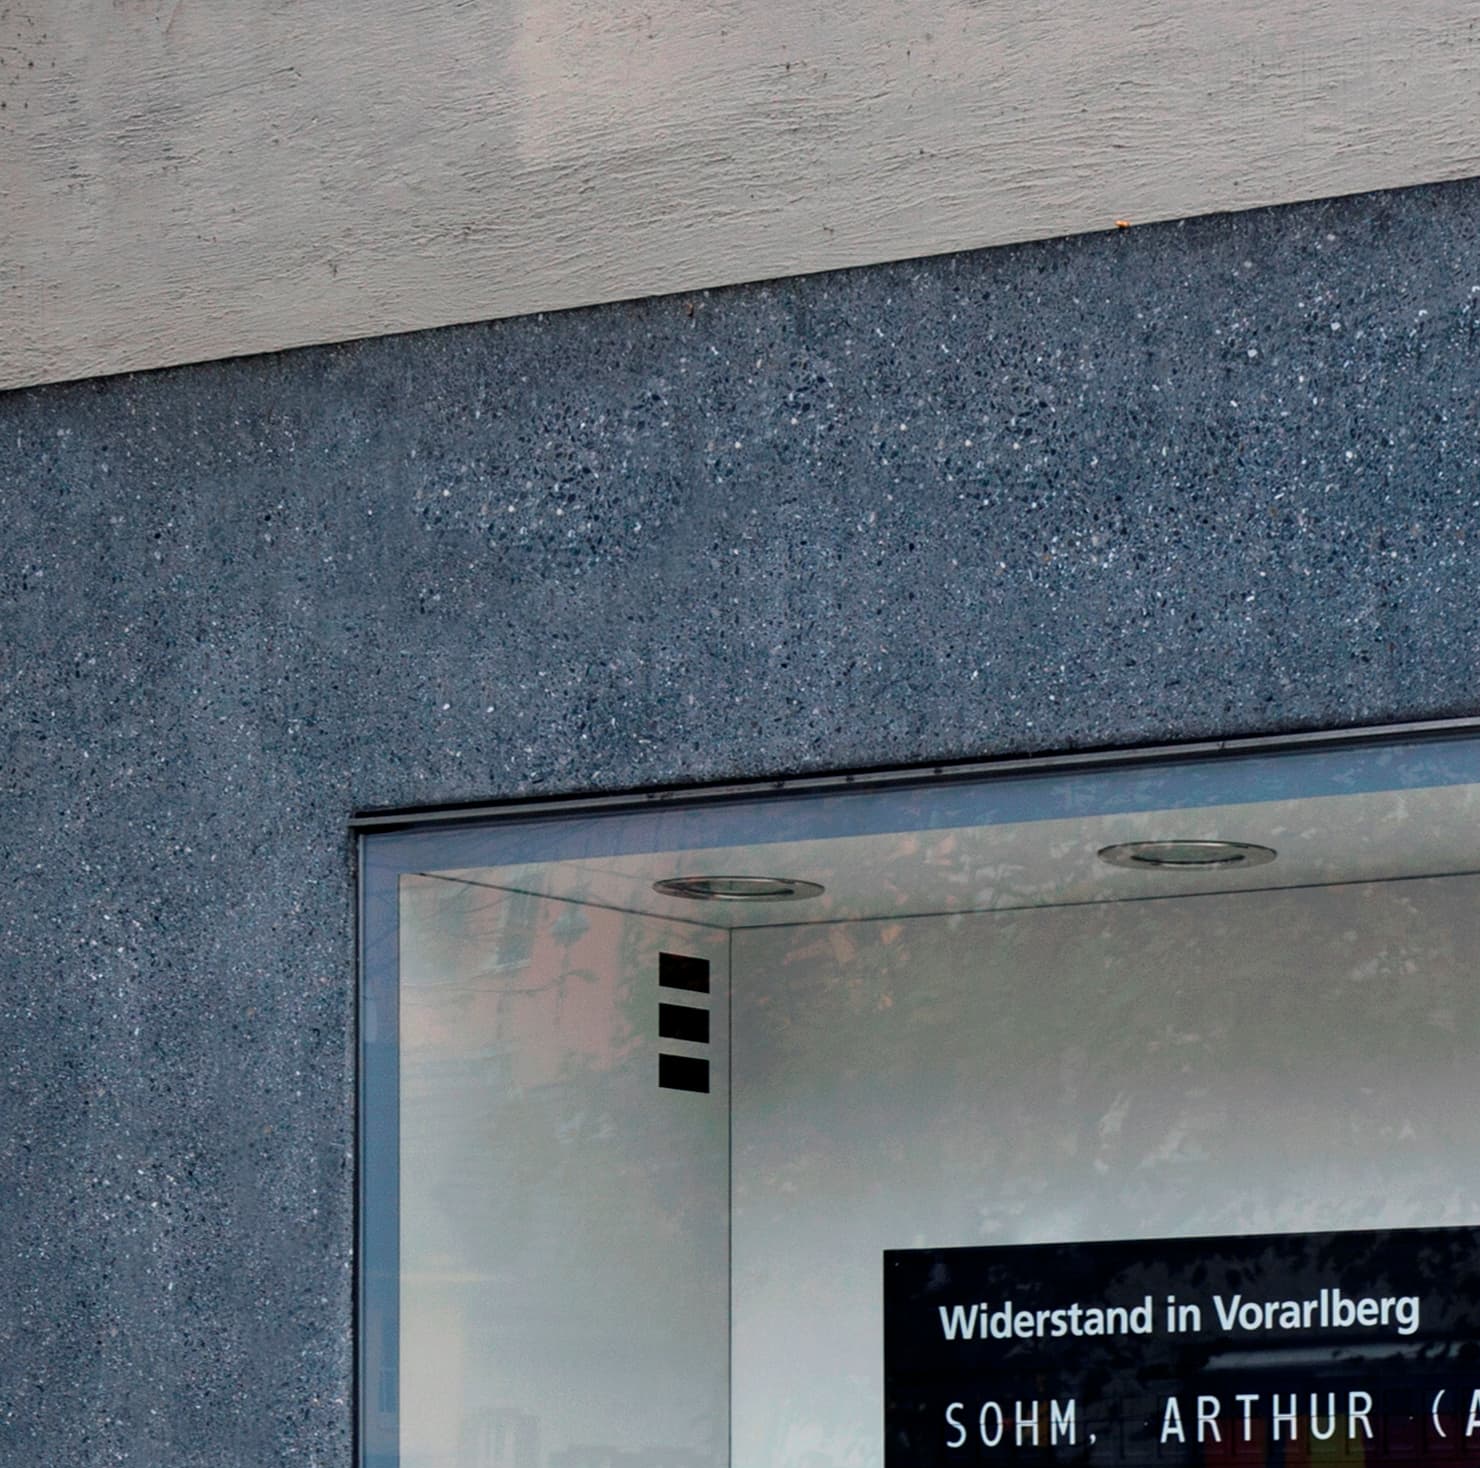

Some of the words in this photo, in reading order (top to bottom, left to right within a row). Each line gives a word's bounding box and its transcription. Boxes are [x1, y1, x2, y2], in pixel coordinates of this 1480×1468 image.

[938, 1295, 1154, 1341] Widerstand
[1166, 1294, 1201, 1333] in
[1212, 1287, 1421, 1335] Vorarlberg
[945, 1399, 1097, 1448] SOHM,
[1160, 1390, 1375, 1444] ARTHUR
